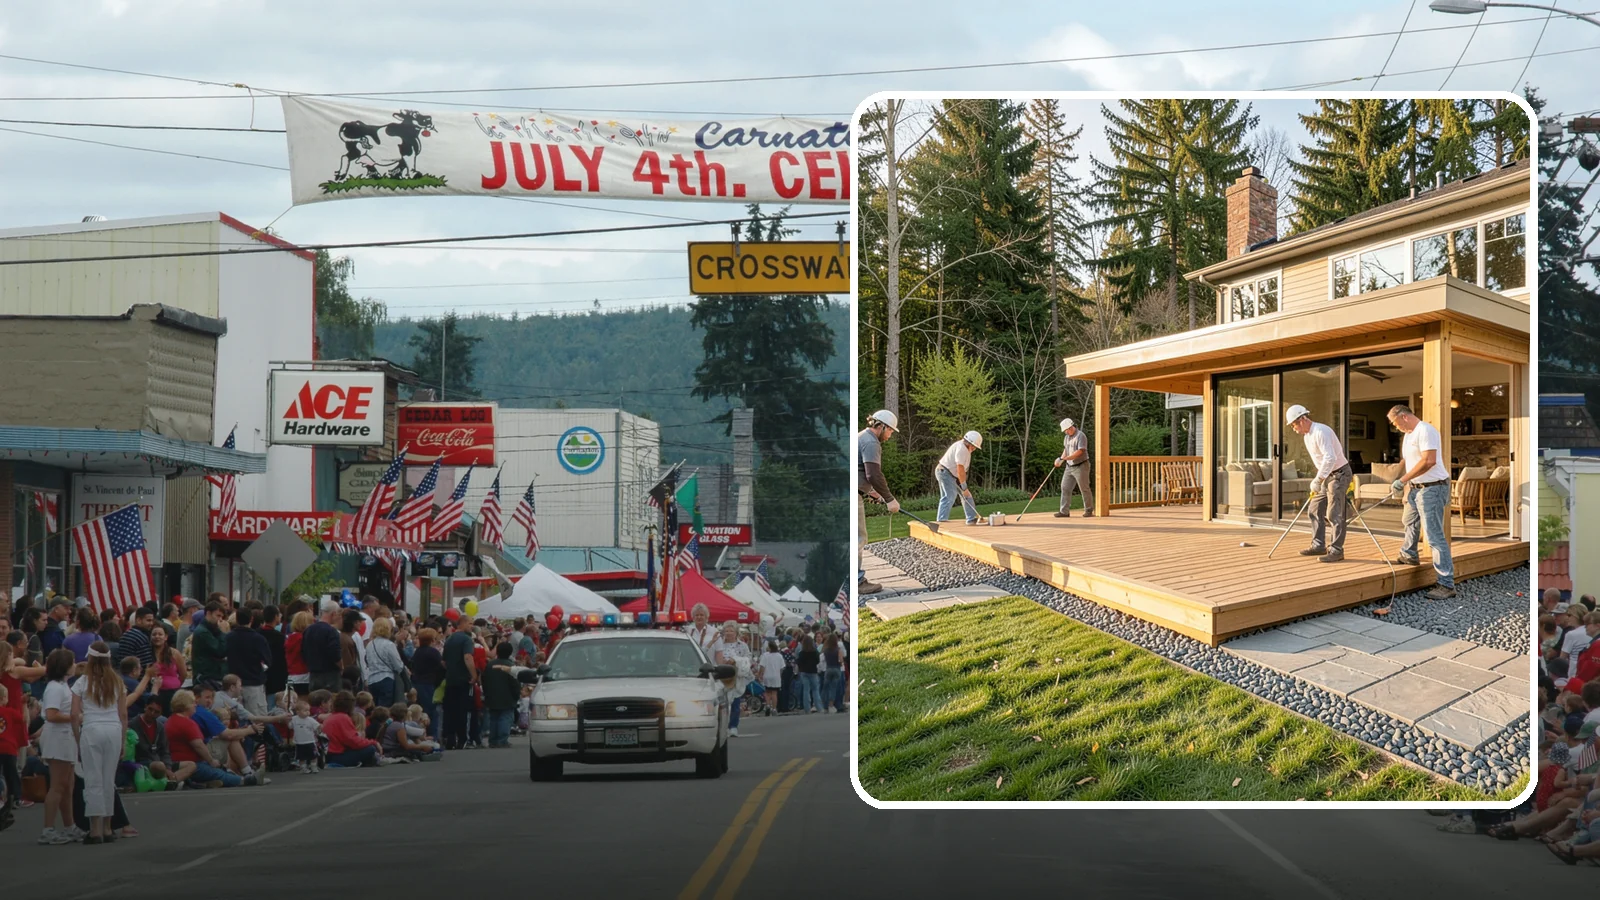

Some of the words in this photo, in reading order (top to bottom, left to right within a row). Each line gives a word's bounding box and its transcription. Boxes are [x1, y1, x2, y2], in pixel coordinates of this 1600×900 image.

[481, 140, 605, 192] JULY
[632, 150, 747, 198] 4th.
[697, 254, 850, 280] CROSSWA
[282, 380, 374, 420] ACE
[406, 409, 453, 422] CEDAR
[283, 421, 371, 436] Hardware
[416, 428, 477, 447] Coca-Cola
[83, 485, 94, 494] St.
[95, 485, 124, 495] Vincent
[126, 486, 136, 495] de
[137, 486, 155, 495] Paul
[212, 516, 331, 534] HARDARE
[688, 526, 742, 535] CRNATION
[699, 535, 730, 544] GLASS
